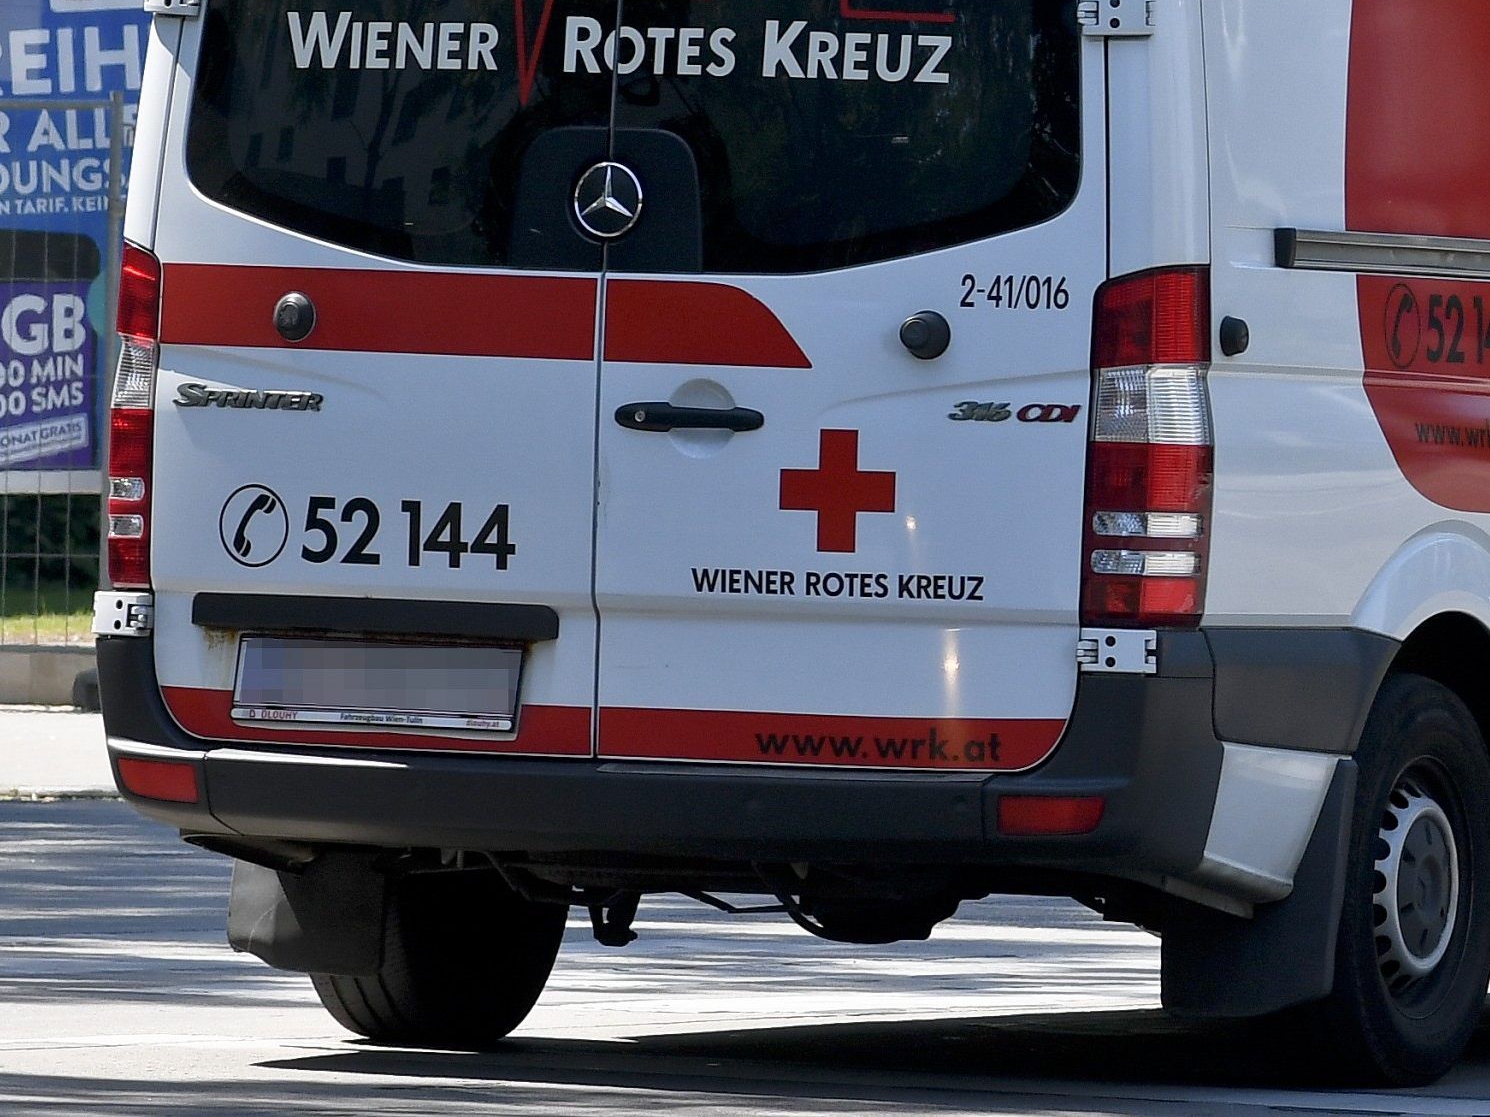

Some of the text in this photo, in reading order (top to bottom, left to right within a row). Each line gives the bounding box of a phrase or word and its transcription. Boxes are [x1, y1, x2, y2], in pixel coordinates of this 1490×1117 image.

[0, 24, 141, 96] EIH
[287, 11, 953, 83] WIENER ROTES KREUZ
[27, 106, 112, 153] ALL
[15, 196, 70, 214] TARIF.
[960, 274, 1070, 310] 2-41/016
[1, 293, 86, 356] GB
[1427, 293, 1465, 363] 52
[30, 353, 85, 384] MIN
[31, 381, 84, 414] SMS
[172, 383, 323, 412] SPRINTER
[1016, 404, 1082, 422] CDI
[301, 496, 517, 571] 52 144
[691, 567, 984, 601] WIENER ROTES KREUZ
[755, 727, 1002, 763] www.wrk.at
